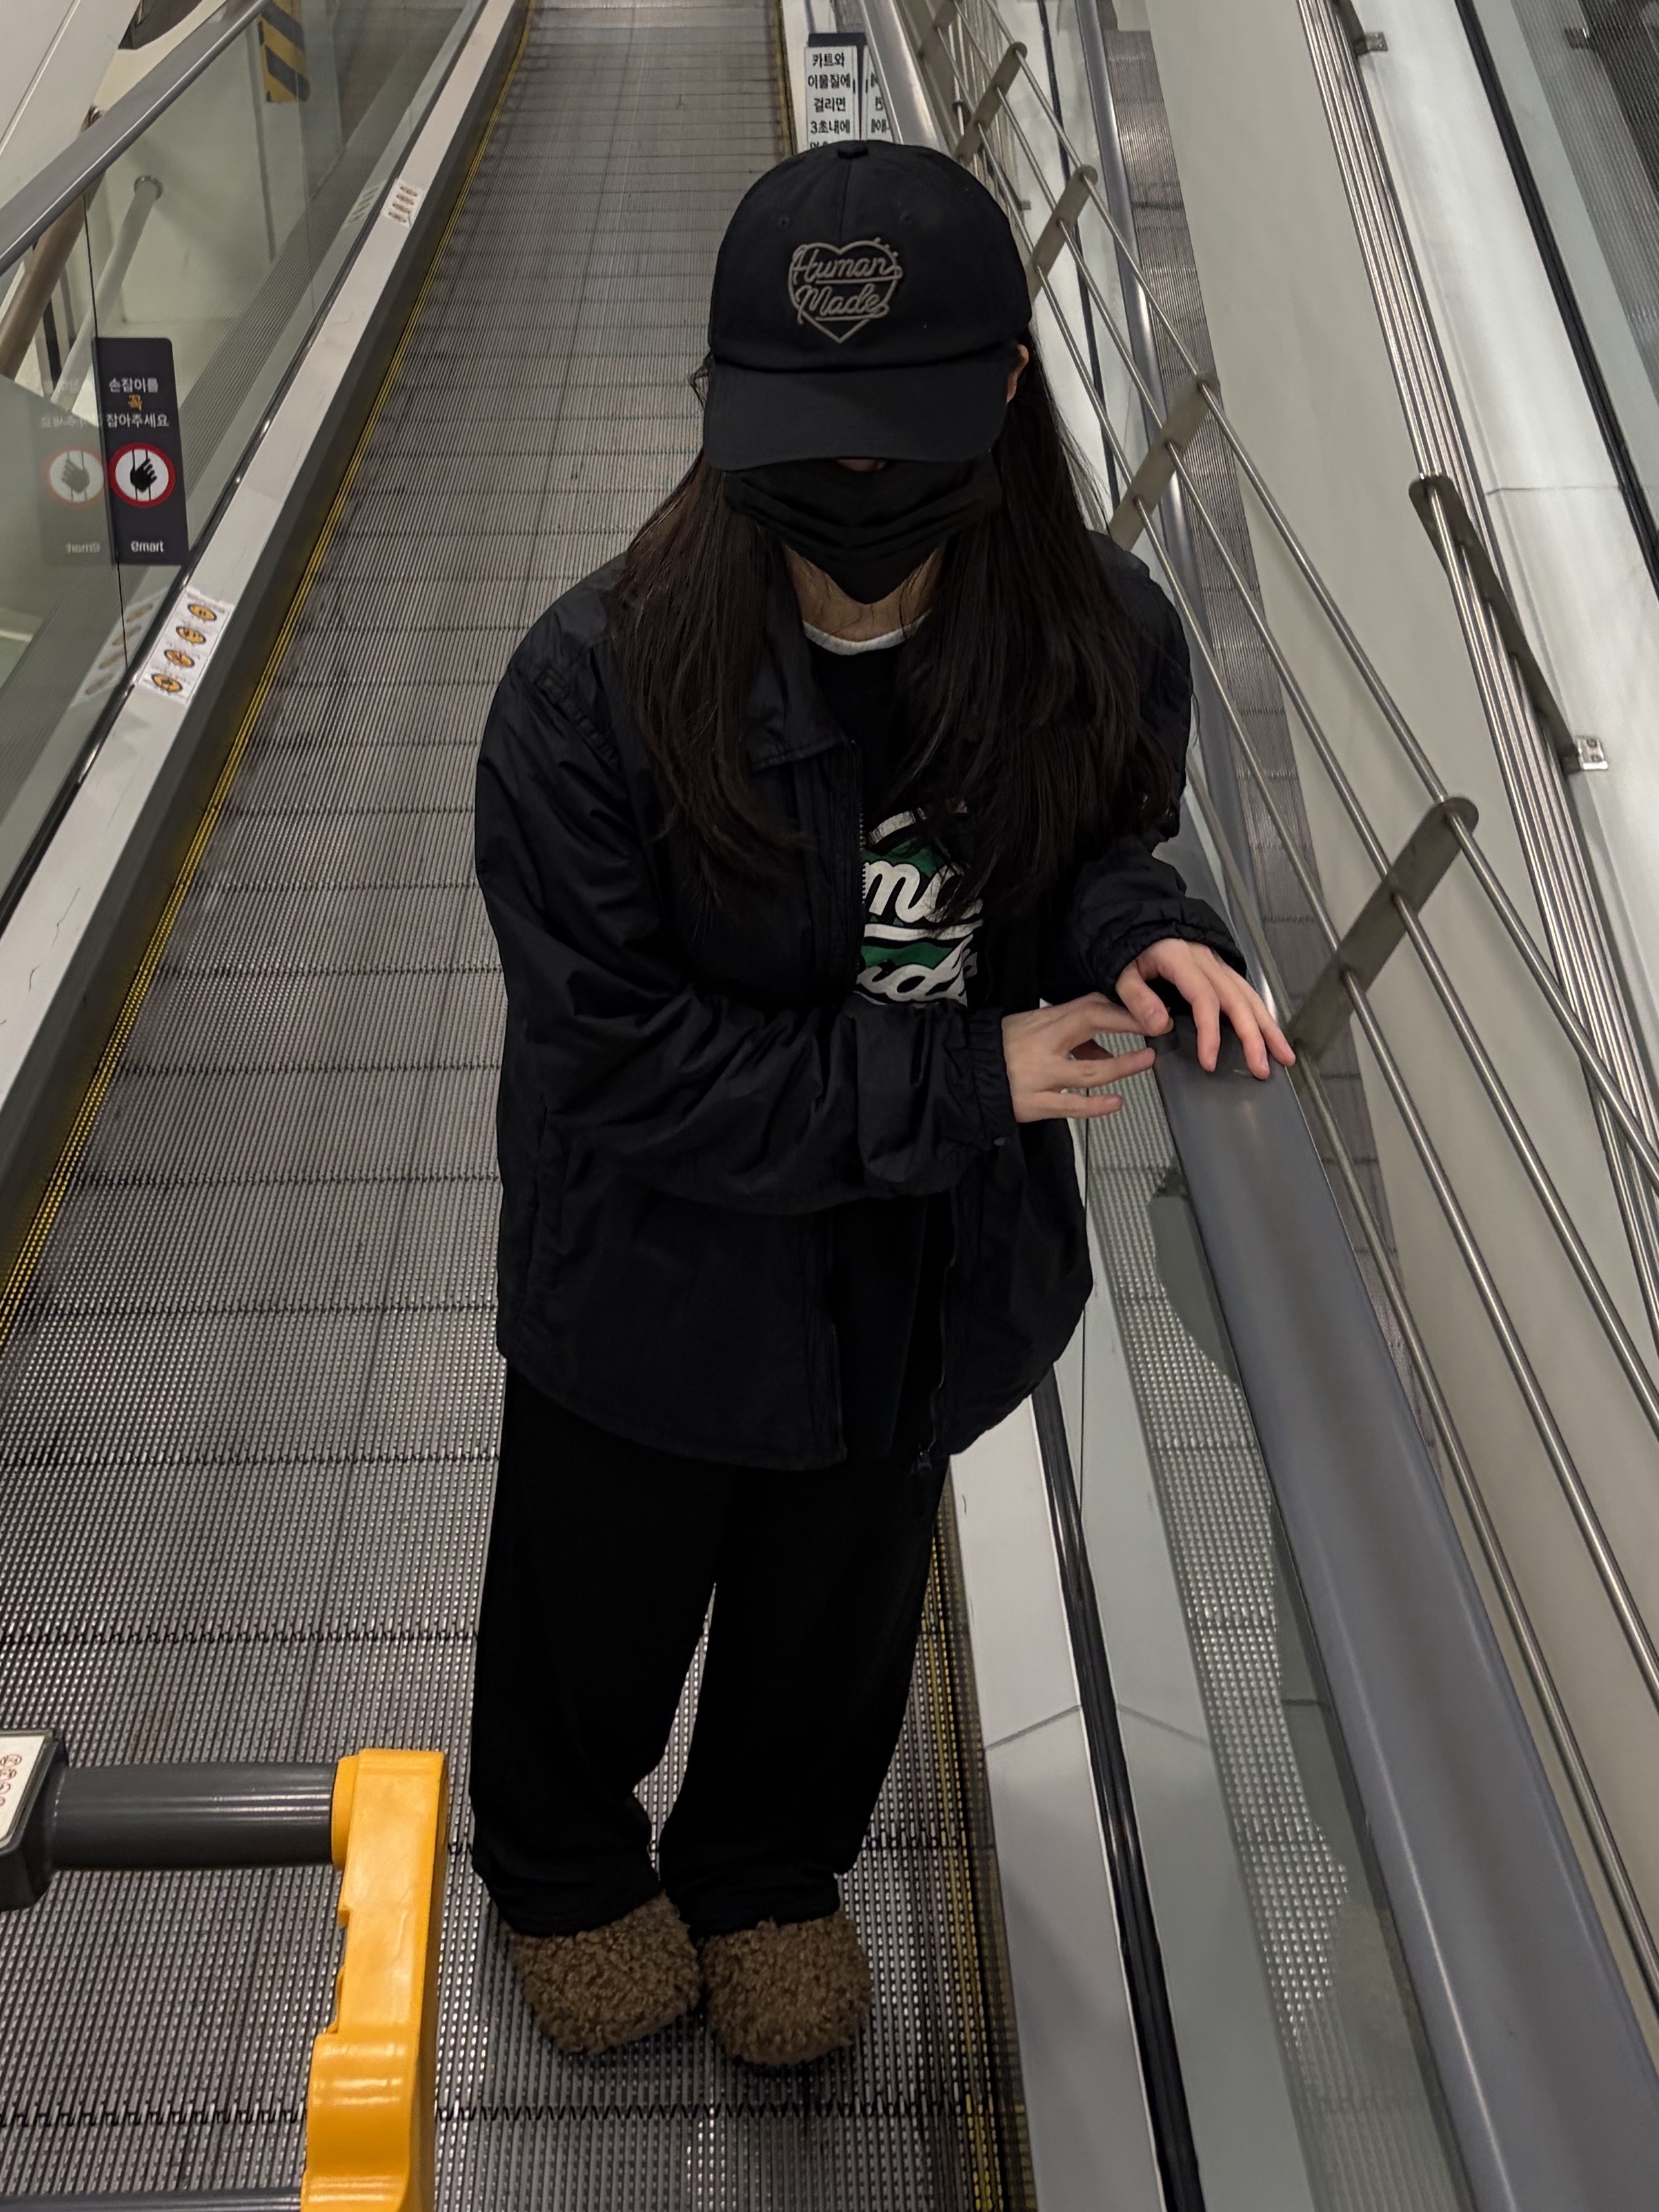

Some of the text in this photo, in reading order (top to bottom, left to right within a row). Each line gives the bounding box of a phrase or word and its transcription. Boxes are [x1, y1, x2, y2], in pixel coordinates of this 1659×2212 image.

[813, 52, 844, 68] 카트와
[808, 73, 851, 89] 이물질에
[814, 97, 846, 112] 걸리면
[811, 119, 850, 134] 3초내에
[793, 244, 902, 285] Human
[795, 284, 890, 324] Made
[109, 377, 158, 393] 손잡이를
[106, 413, 170, 428] 잡아주세요
